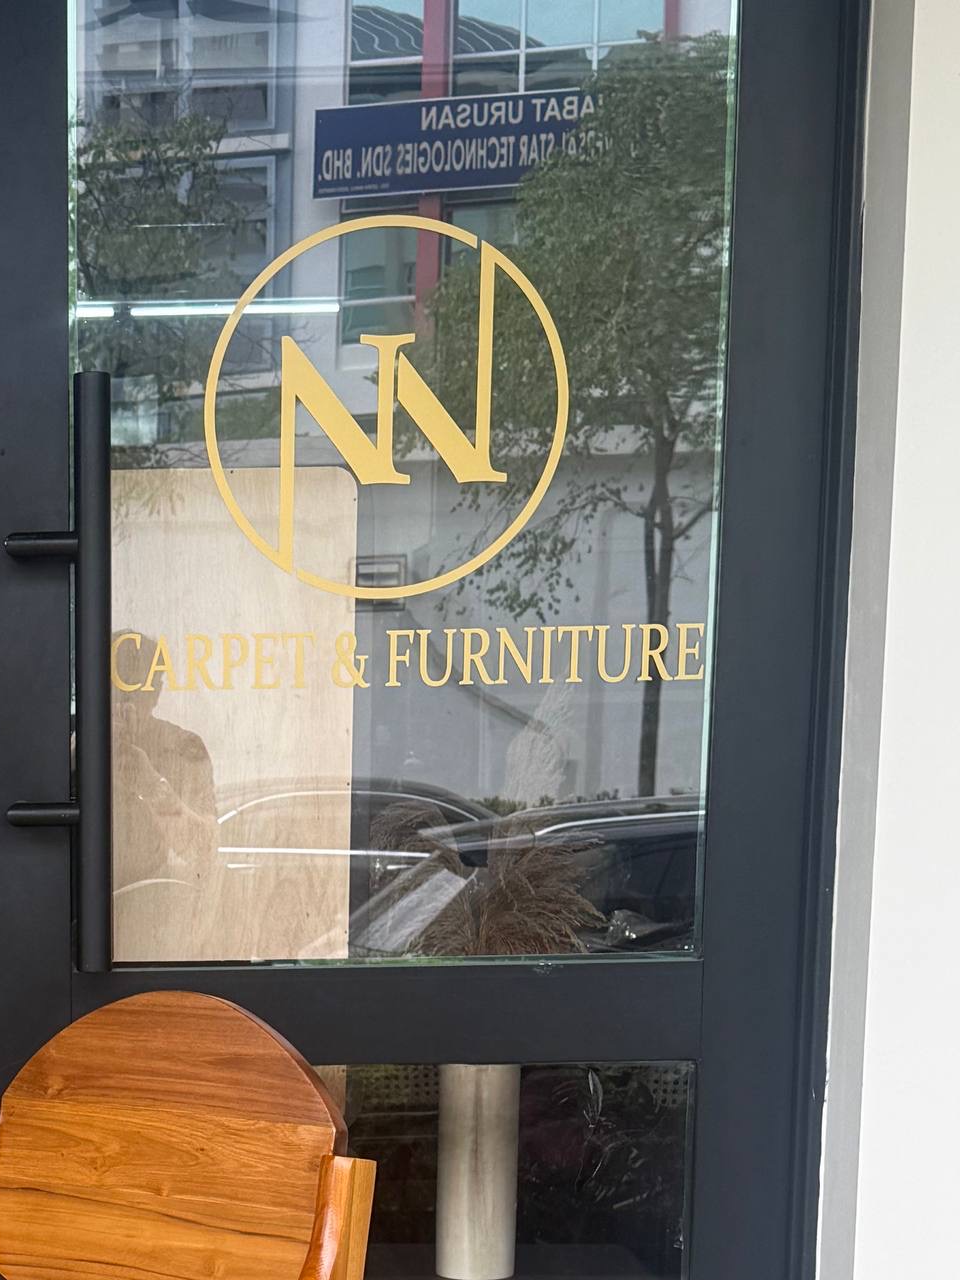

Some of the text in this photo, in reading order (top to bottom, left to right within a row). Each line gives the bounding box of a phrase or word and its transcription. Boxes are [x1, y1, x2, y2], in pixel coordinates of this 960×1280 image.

[110, 622, 706, 693] CARPET & FURNITURE
